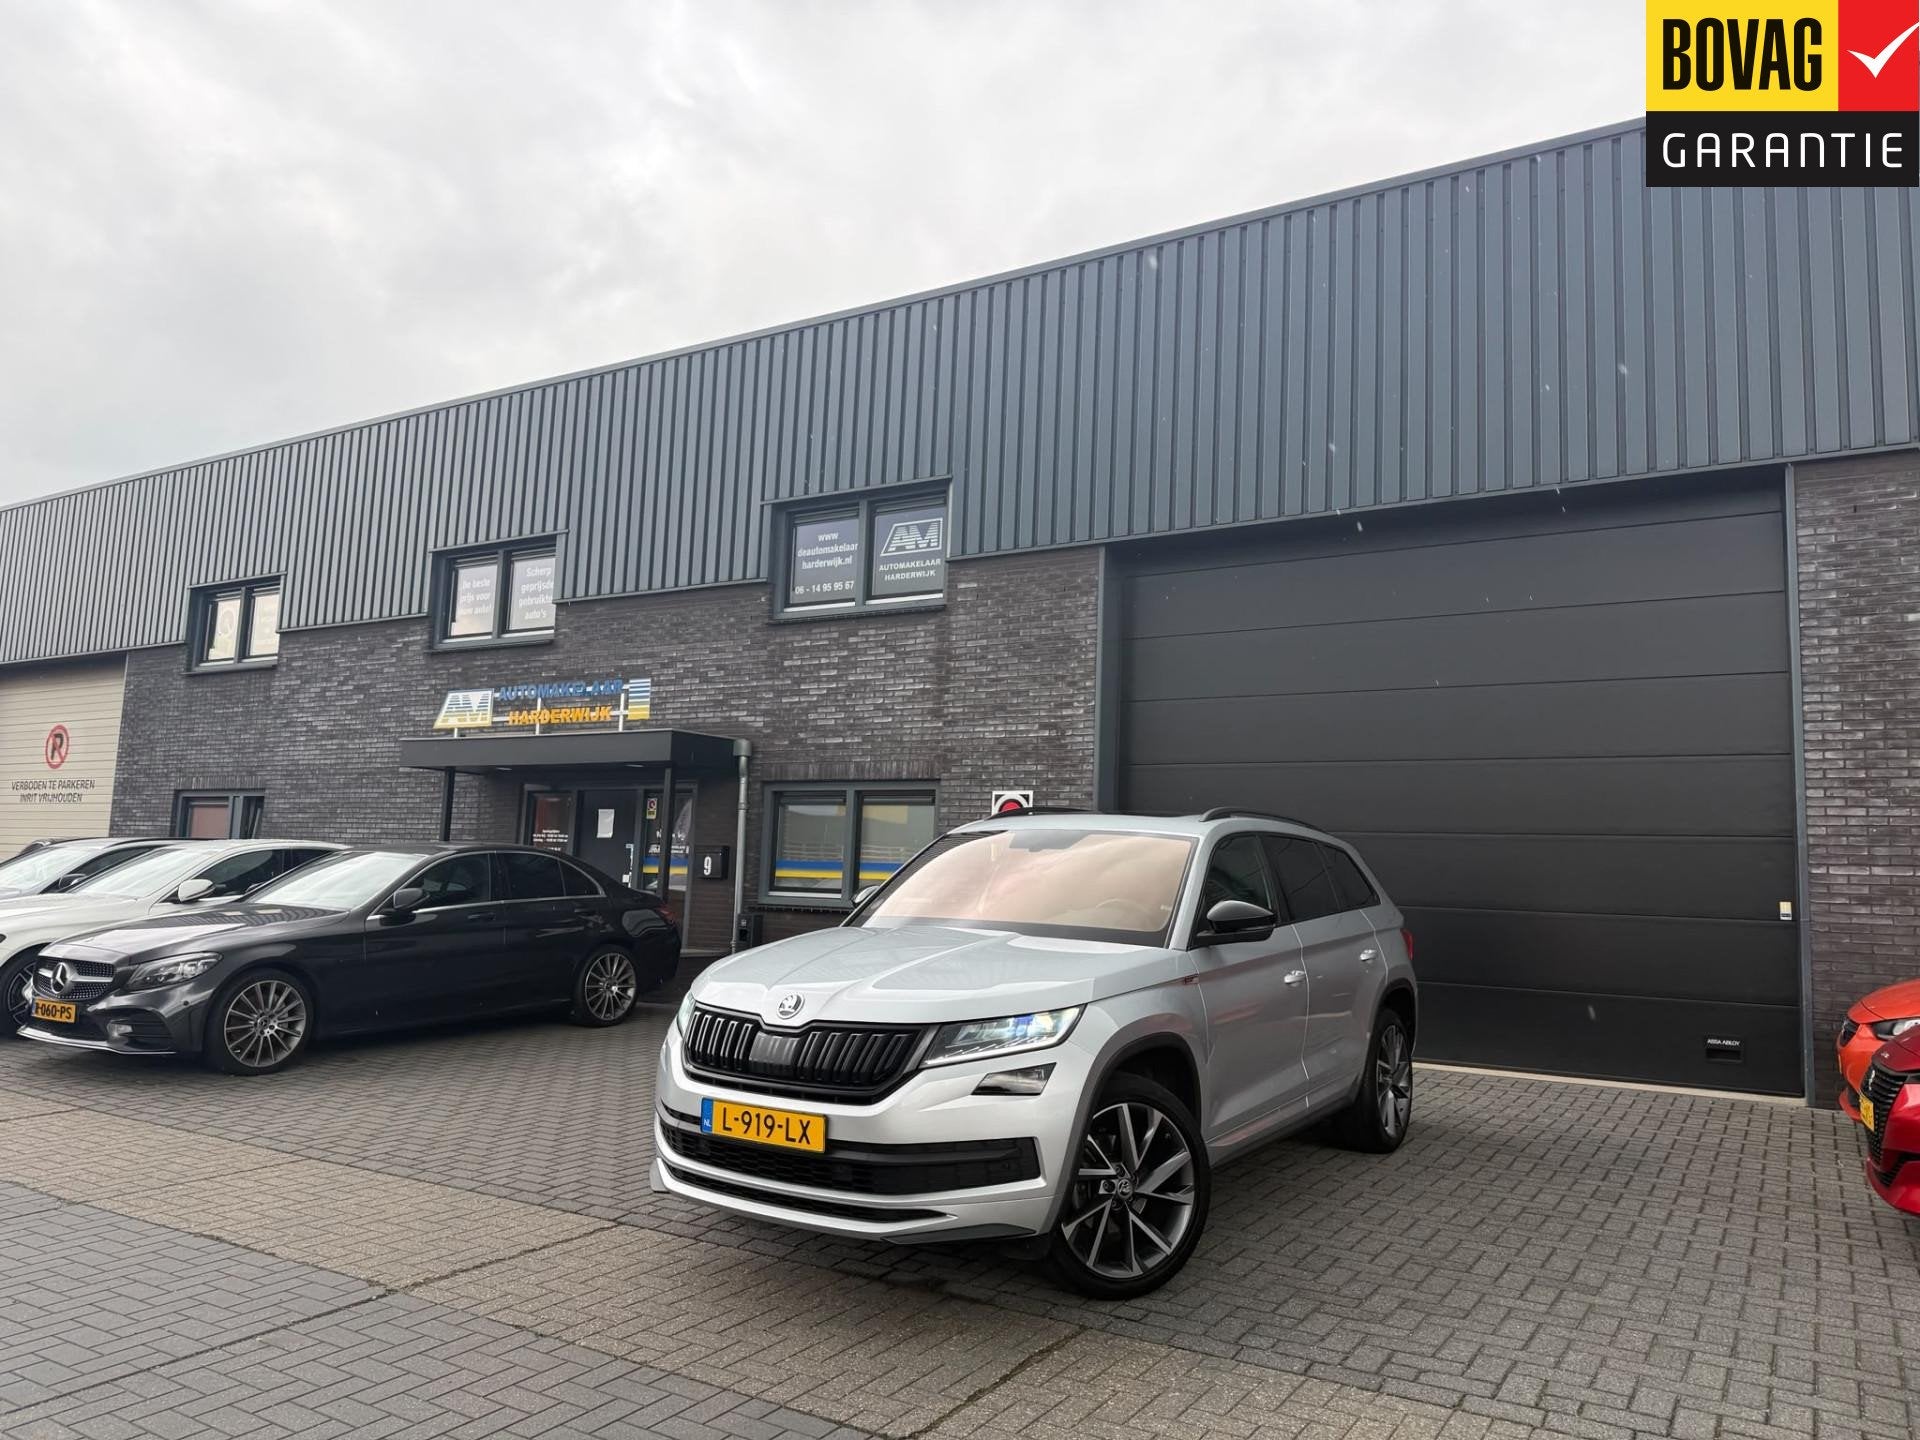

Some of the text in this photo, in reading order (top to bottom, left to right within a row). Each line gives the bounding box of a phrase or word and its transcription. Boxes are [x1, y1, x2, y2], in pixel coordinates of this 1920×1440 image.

[818, 532, 839, 542] www
[888, 522, 939, 552] AM
[798, 543, 858, 557] deautomakelaar
[802, 555, 852, 570] harderwijk.nl
[879, 558, 941, 572] AUTOMAKELAAR
[884, 570, 936, 581] HARDERWIJK
[508, 706, 613, 725] HARDERWIJK
[12, 779, 95, 791] VERBODEN TE PARKEREN
[20, 792, 83, 802] INRIT VRIJHOUDEN
[703, 856, 712, 875] 9
[703, 1107, 811, 1145] NL L-919-LX
